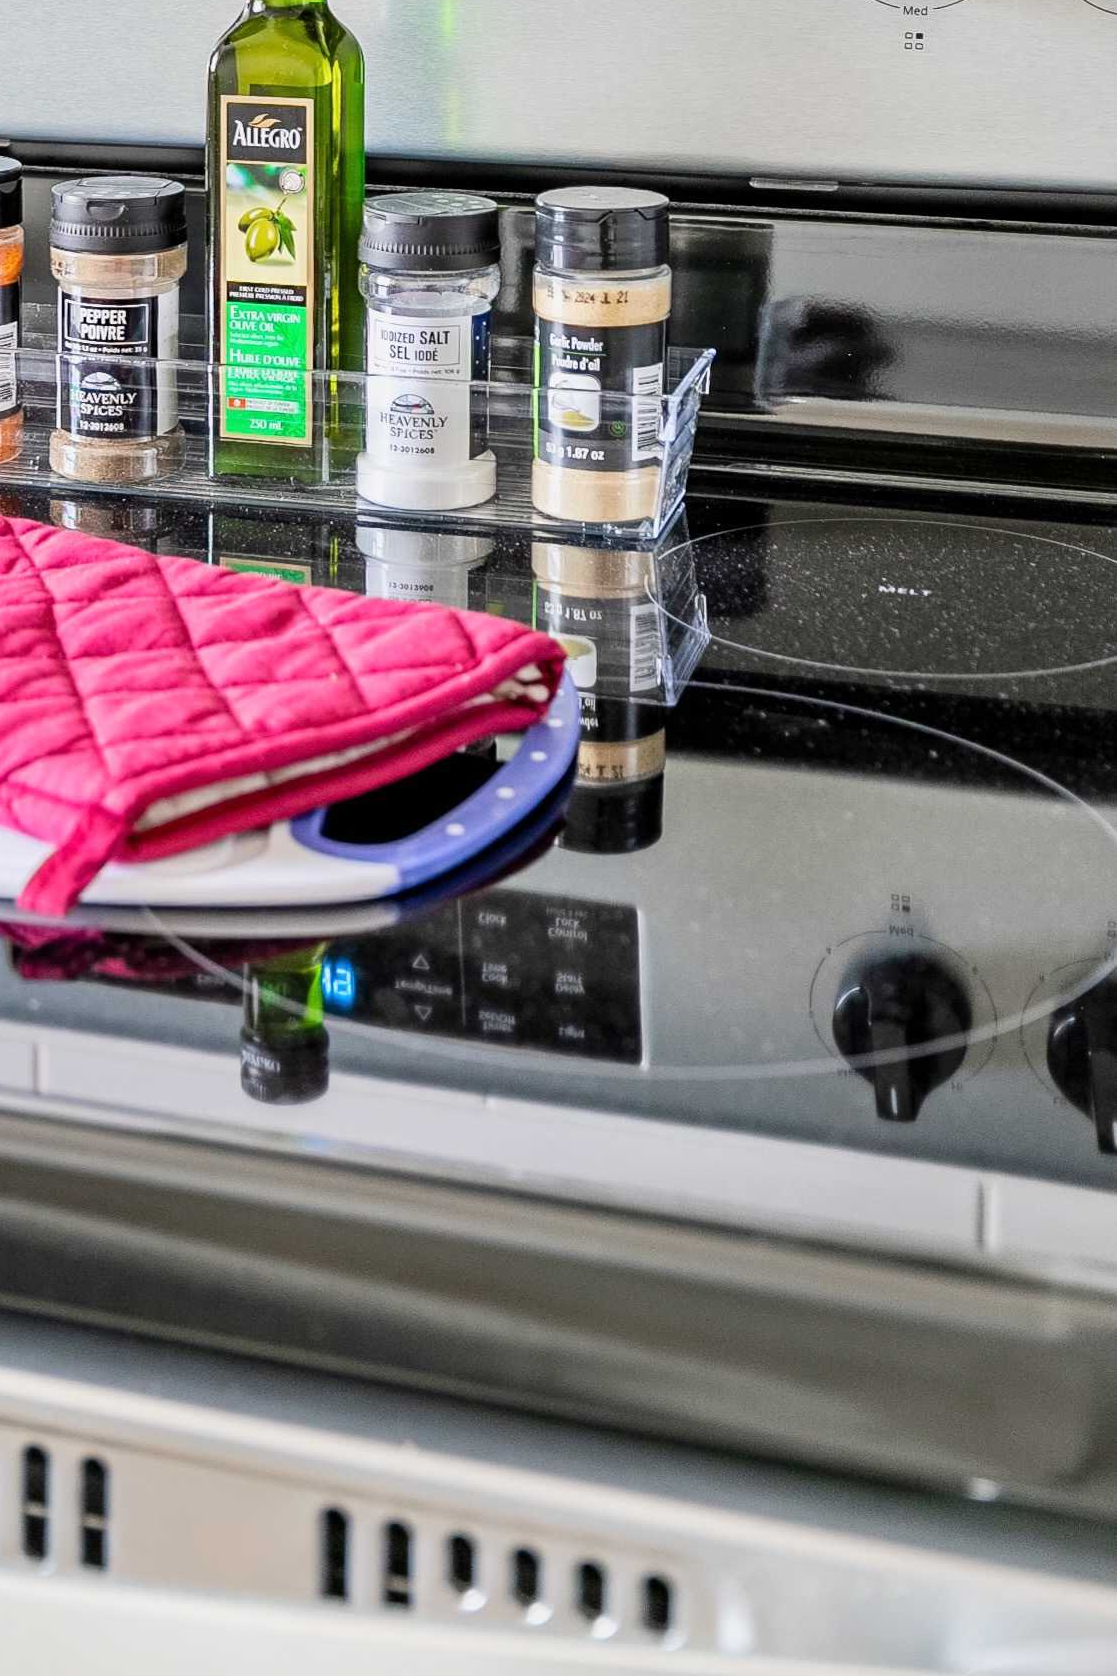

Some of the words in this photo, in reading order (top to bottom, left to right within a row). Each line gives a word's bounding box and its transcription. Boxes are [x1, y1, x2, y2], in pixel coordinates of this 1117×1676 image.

[903, 6, 928, 16] Med
[232, 120, 302, 150] ALLEGRO
[80, 307, 127, 325] PEPPER
[230, 305, 265, 322] EXTRA
[80, 324, 125, 341] POIVRE
[230, 320, 258, 331] OLIVE
[259, 321, 275, 333] OIL
[381, 329, 415, 344] IODIZED
[419, 330, 451, 345] SALT
[549, 332, 571, 349] Garlic
[571, 337, 604, 352] Powder
[230, 348, 262, 364] HUILE
[389, 344, 411, 361] SEL
[415, 347, 439, 362] IODÉ
[551, 356, 578, 371] Poudre
[71, 389, 137, 405] HEAVENLY
[80, 404, 124, 417] SPICES
[250, 419, 268, 429] 250
[379, 412, 449, 428] HEAVENLY
[389, 426, 434, 440] SPICES
[389, 444, 435, 454] 12-3012608
[566, 446, 590, 460] 1.87
[590, 449, 605, 461] oz
[878, 584, 933, 597] MELT
